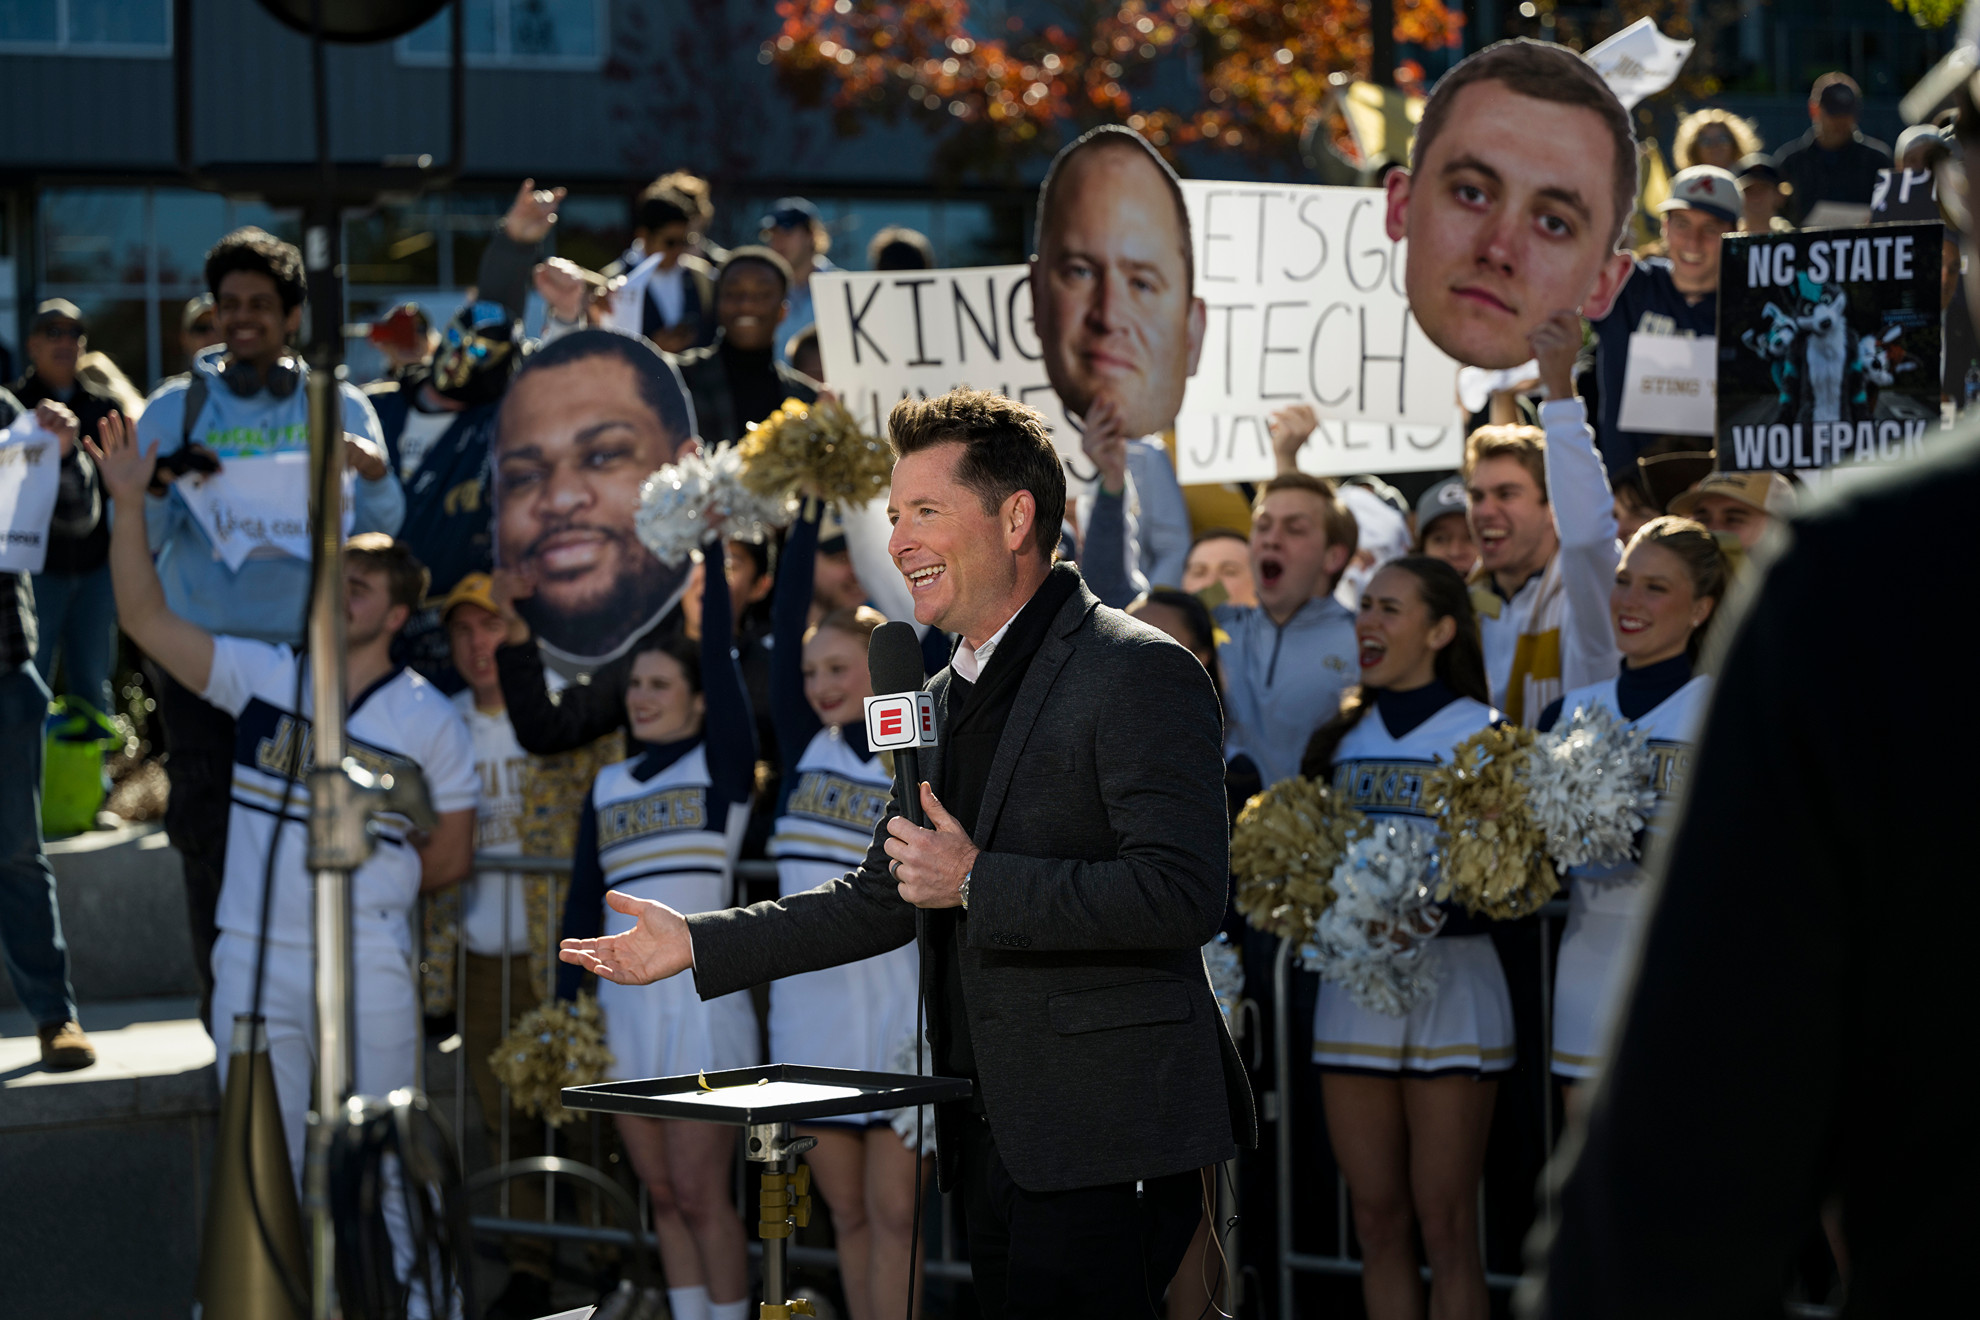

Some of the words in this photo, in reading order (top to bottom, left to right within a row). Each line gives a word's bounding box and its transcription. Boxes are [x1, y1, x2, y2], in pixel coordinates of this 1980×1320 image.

[1202, 189, 1328, 284] ET'S
[1748, 242, 1796, 288] NC
[1807, 236, 1914, 284] STATE
[1204, 301, 1411, 415] TECH
[1731, 418, 1927, 470] WOLFPACK
